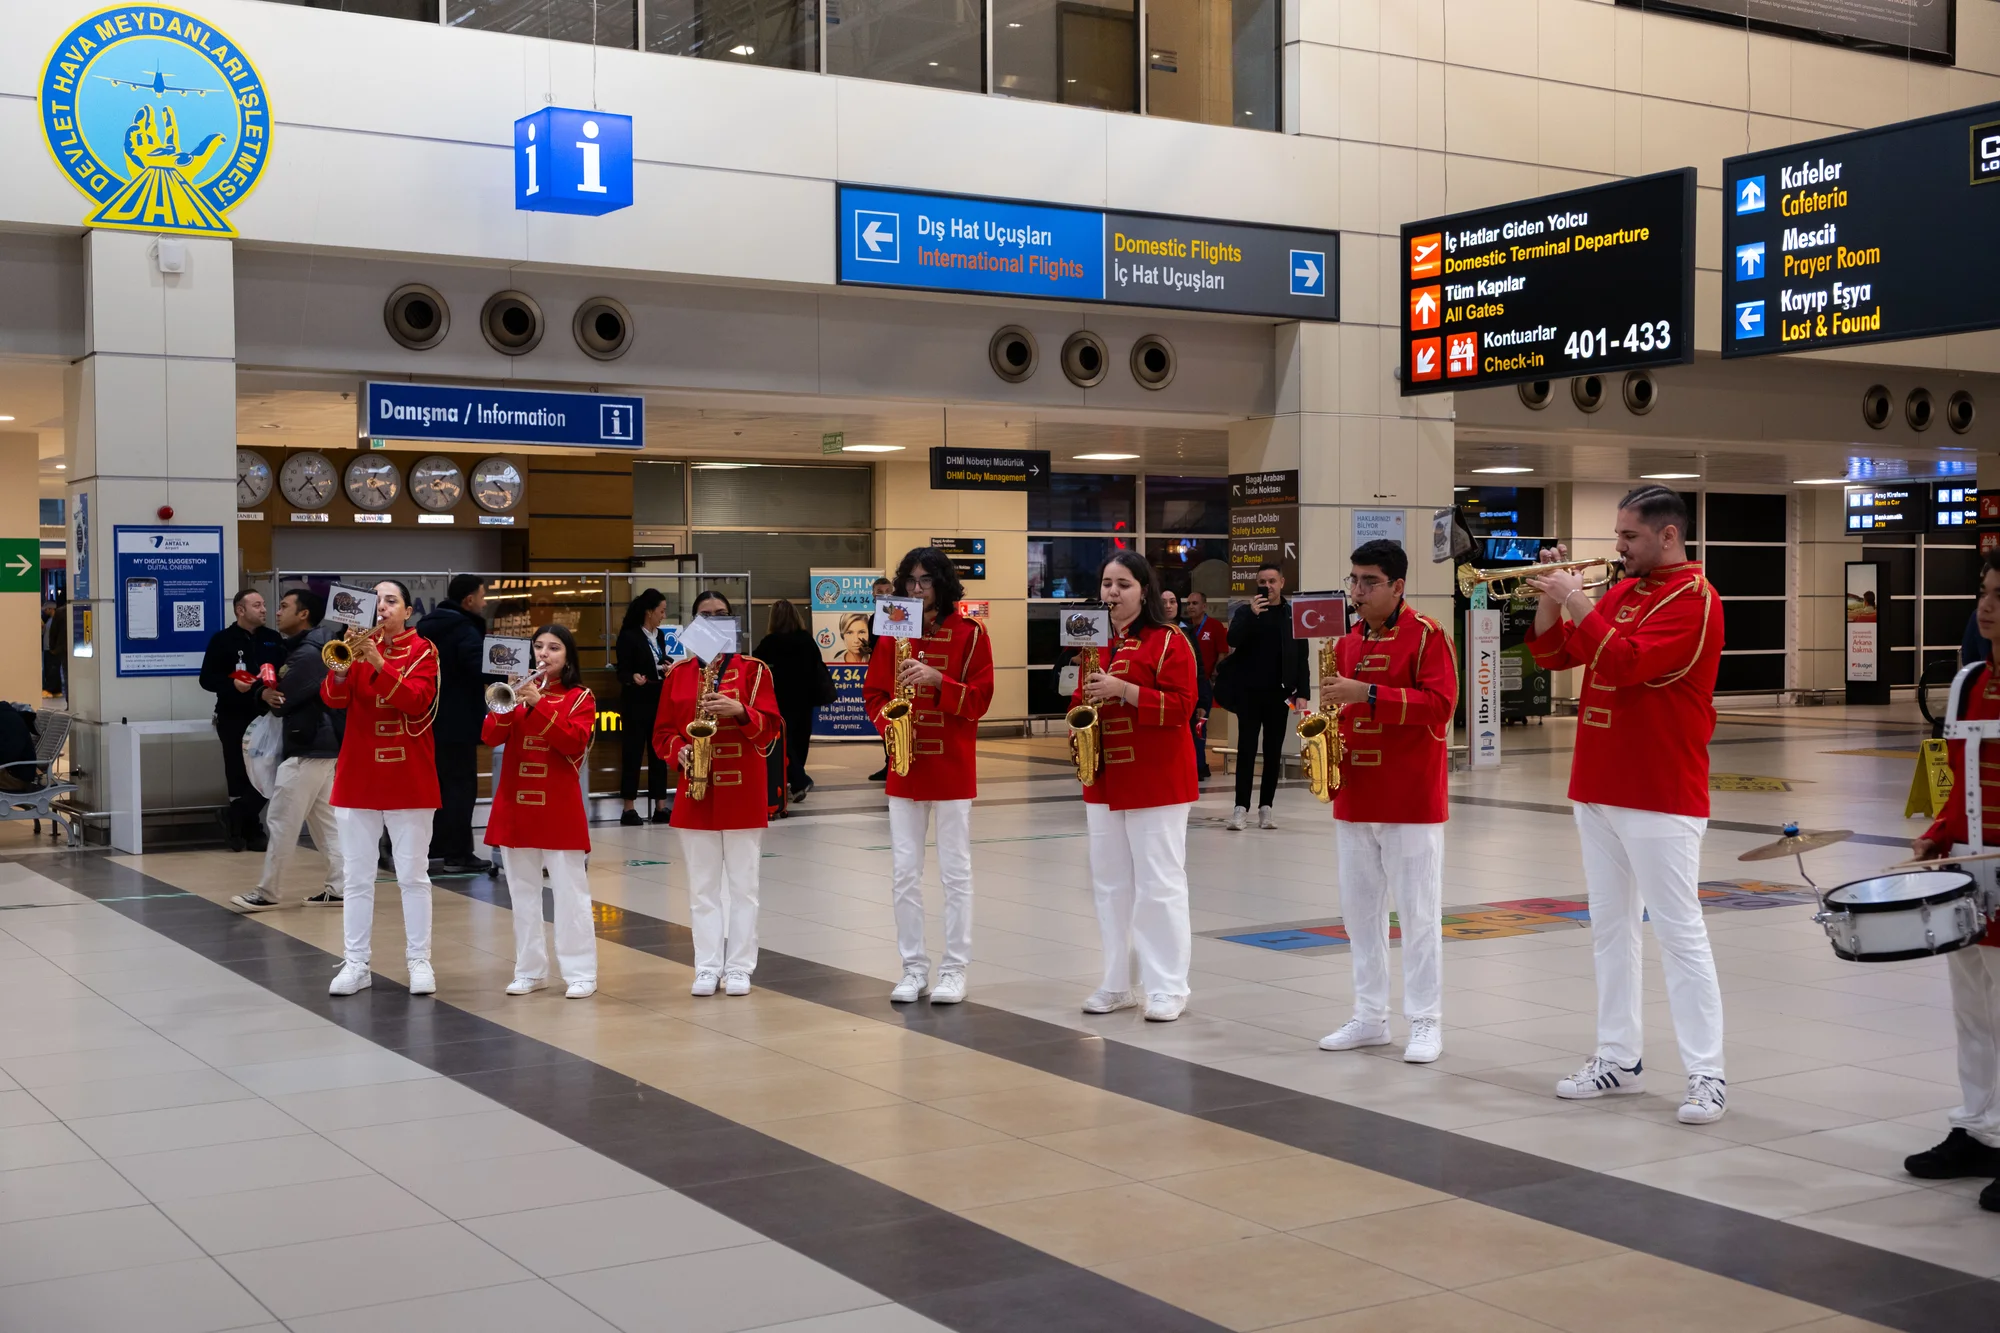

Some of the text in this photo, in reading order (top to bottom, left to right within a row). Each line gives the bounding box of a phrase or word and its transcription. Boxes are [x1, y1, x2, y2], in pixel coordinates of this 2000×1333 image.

[52, 12, 263, 206] DEVLET HAVA MEYDANLARI İŞLETMESİ
[1781, 158, 1842, 190] Kafeler
[1781, 186, 1848, 217] Cafeteria
[918, 215, 1052, 248] Dış Hat Uçuşları
[1444, 211, 1588, 253] İç Hatlar Giden Yolcu
[1782, 222, 1836, 252] Mescit
[1114, 232, 1242, 266] Domestic Flights
[1444, 226, 1650, 274] Domestic Terminal Departure
[1784, 246, 1880, 280] Prayer Room
[918, 246, 1084, 282] International Flights
[1114, 258, 1225, 292] İç Hat Uçuşları
[1445, 275, 1526, 302] Tüm Kapılar
[1781, 282, 1871, 315] Kayıp Eşya
[1445, 302, 1505, 323] All Gates
[1782, 306, 1880, 342] Lost & Found
[1484, 320, 1671, 360] Kontuarlar 401-433
[1484, 352, 1544, 373] Check-in
[380, 398, 458, 427] Danışma
[464, 403, 472, 425] /
[478, 404, 566, 427] Information
[946, 454, 1024, 468] DHMİ Nöbetçi Müdürlük
[946, 470, 1026, 482] DHMİ Duty Management
[1259, 486, 1282, 494] Noktası
[1263, 474, 1286, 482] Arabası
[1232, 513, 1280, 524] Emanet Dolabı
[1232, 526, 1276, 536] Safety Lockers
[1232, 542, 1278, 553] Araç Kiralama
[1244, 554, 1263, 562] Rental
[1232, 571, 1258, 580] Bankam
[1232, 583, 1245, 591] ATM
[842, 596, 858, 604] 444
[844, 669, 860, 680] 34
